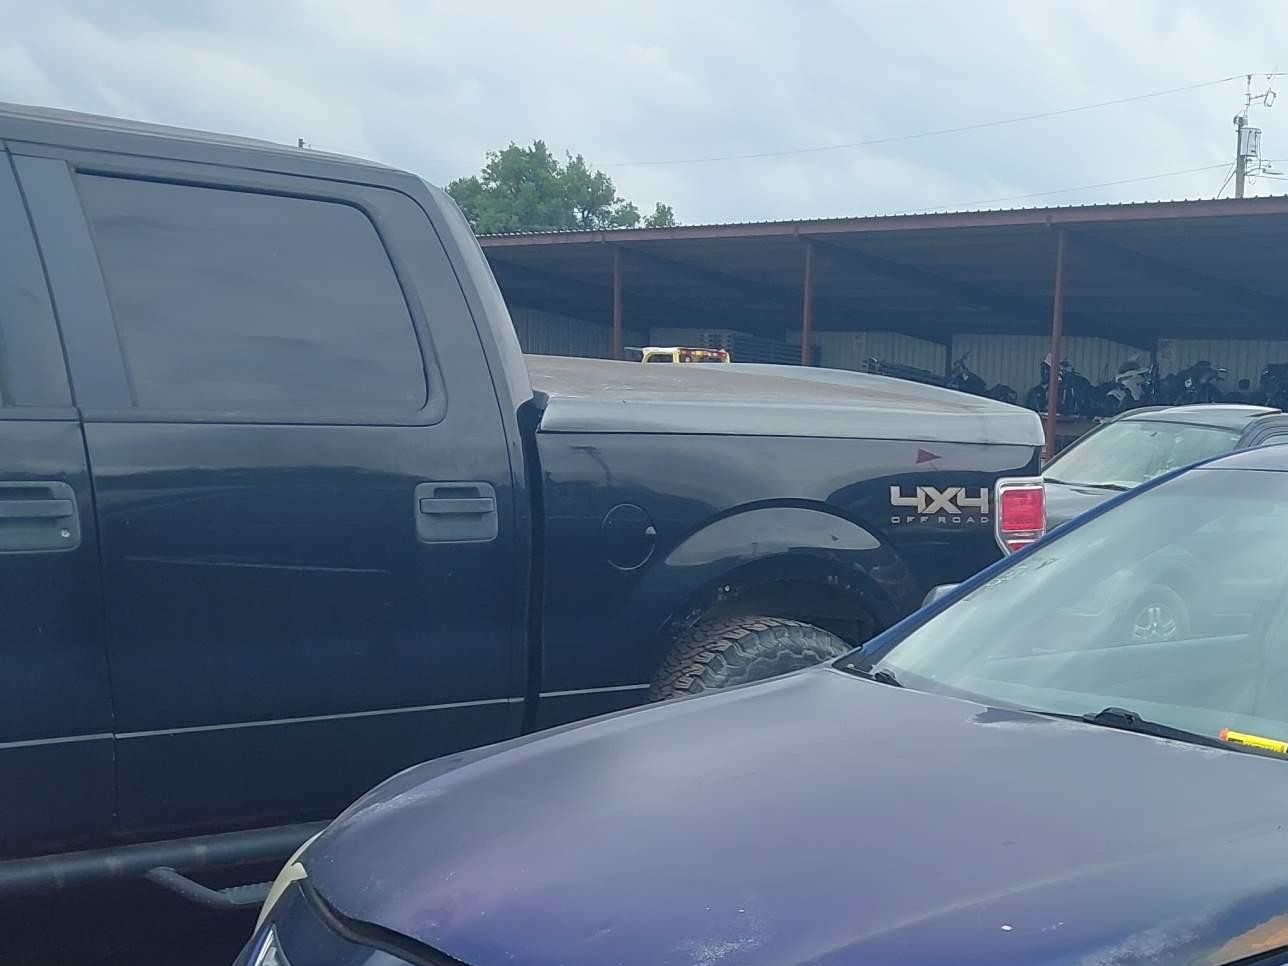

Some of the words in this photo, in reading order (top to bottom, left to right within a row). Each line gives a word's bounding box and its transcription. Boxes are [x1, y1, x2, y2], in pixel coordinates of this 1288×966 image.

[890, 486, 989, 513] 4X4
[891, 516, 929, 524] OFF
[938, 516, 989, 524] ROAD
